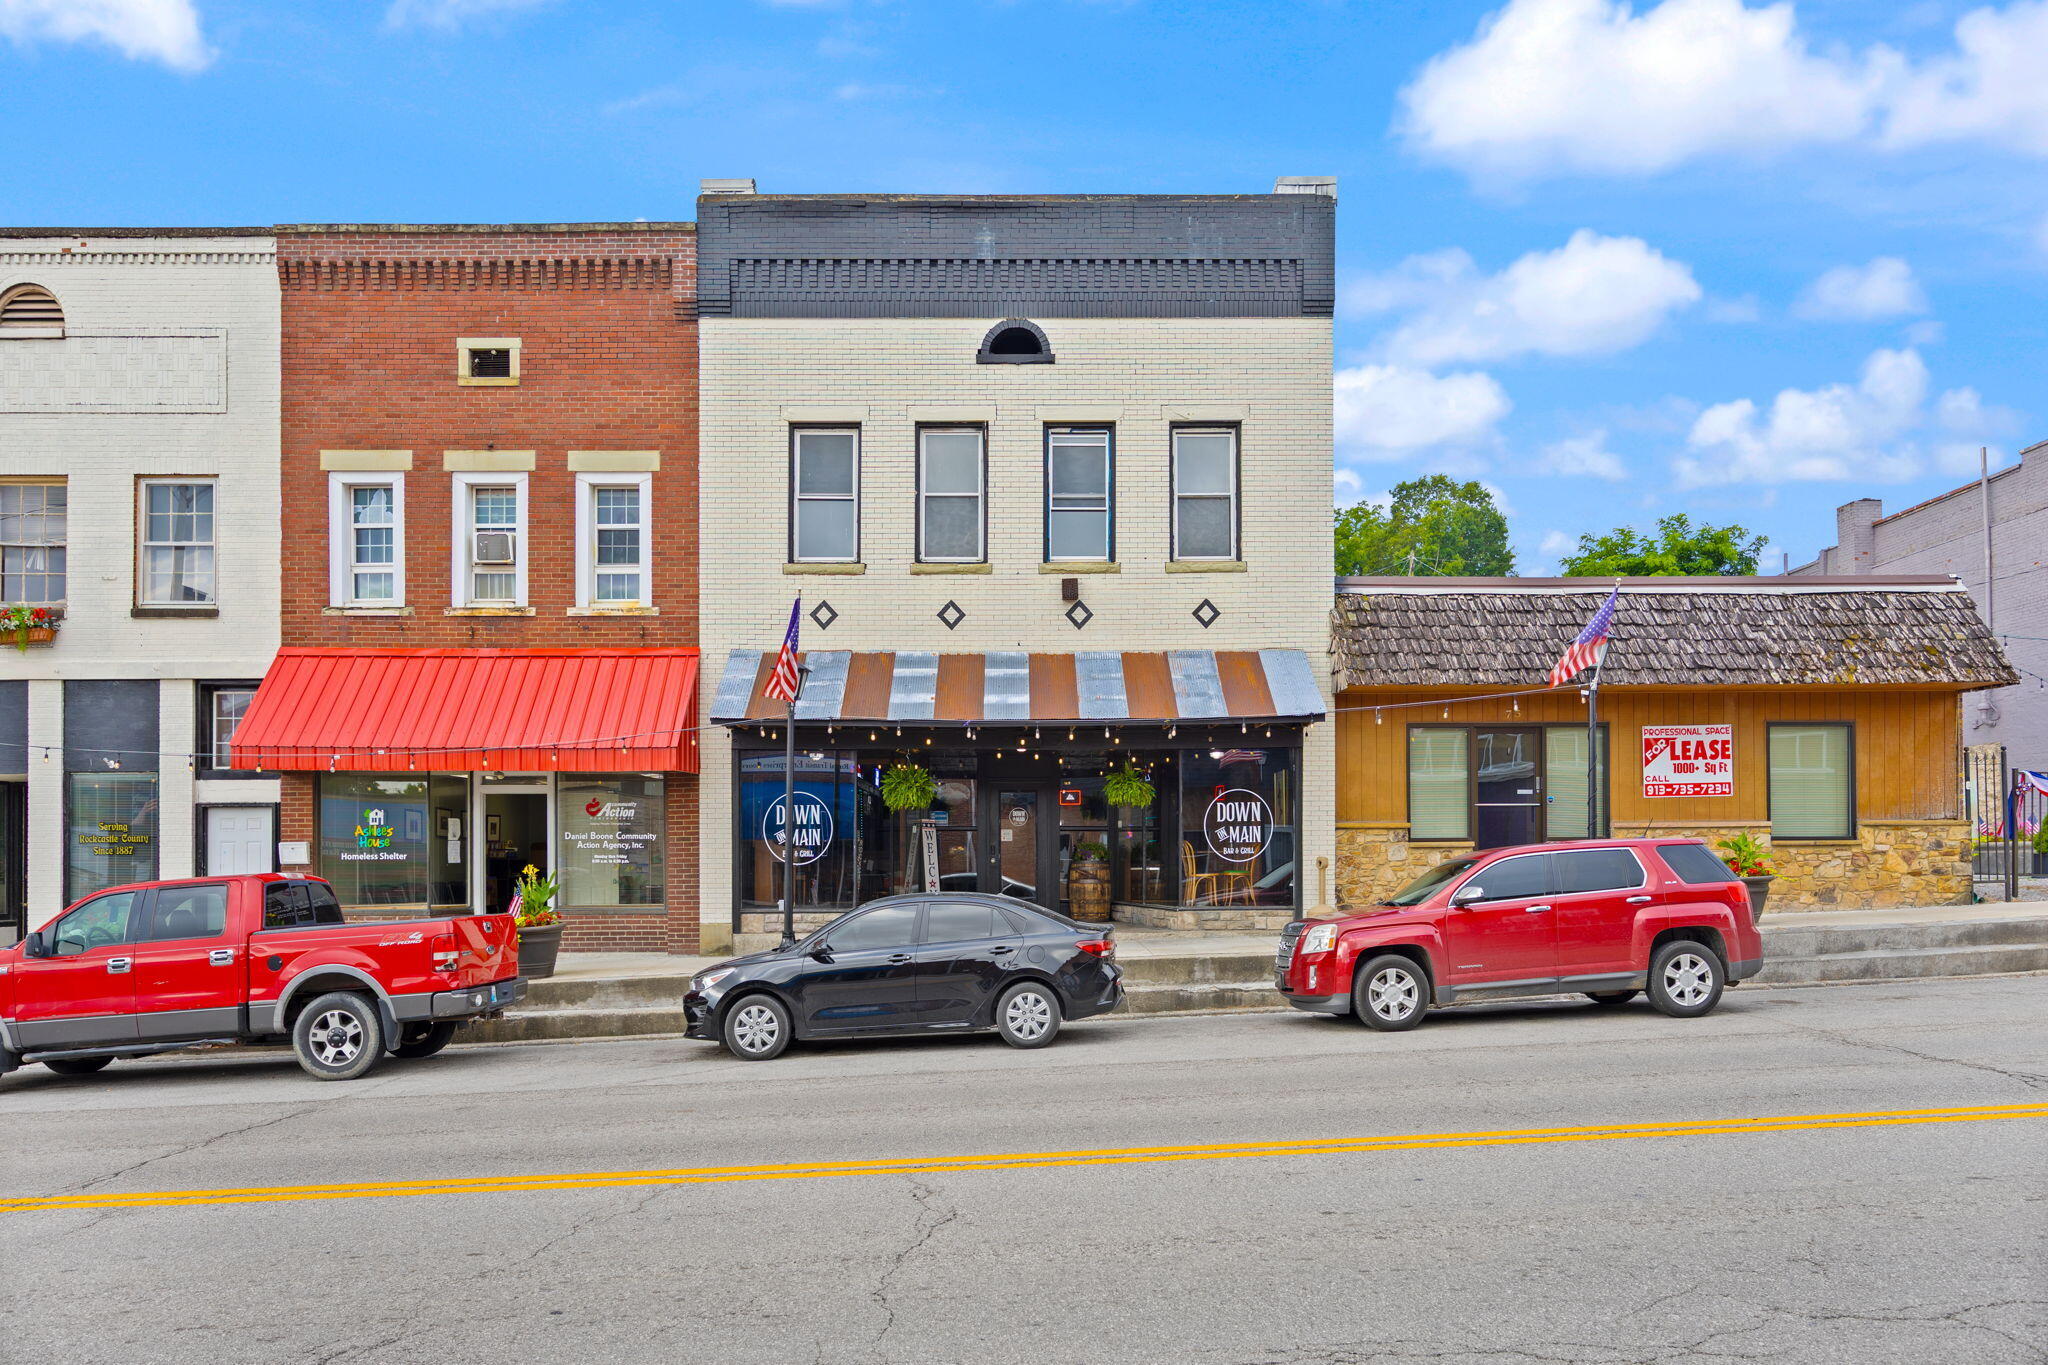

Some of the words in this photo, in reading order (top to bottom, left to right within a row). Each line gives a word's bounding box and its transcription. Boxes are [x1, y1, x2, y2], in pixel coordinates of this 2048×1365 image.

[1644, 728, 1702, 736] PROFESSIONAL
[1705, 726, 1730, 735] SPACE
[1645, 739, 1667, 760] FOR
[1670, 740, 1731, 760] LEASE
[1704, 762, 1716, 775] Sq
[1719, 762, 1728, 772] Ft
[1646, 784, 1730, 796] 913-735-7234
[597, 802, 634, 816] Action
[1216, 802, 1261, 822] DOWN
[776, 804, 820, 825] DWN
[98, 822, 128, 832] Serving
[80, 834, 118, 844] Rockcastle
[121, 834, 149, 844] County
[564, 832, 588, 840] Daniel
[590, 832, 614, 840] Boone
[616, 832, 656, 841] Community
[792, 828, 820, 846] MAIN
[1214, 826, 1229, 842] ON
[1229, 826, 1262, 843] MAIN
[576, 840, 600, 848] Action
[602, 840, 630, 850] Agency,
[1240, 846, 1254, 854] GRILL
[93, 846, 114, 856] Since
[115, 846, 134, 855] 1887
[341, 852, 378, 860] Homeless
[380, 852, 408, 860] Shelter
[800, 850, 814, 858] GRILL
